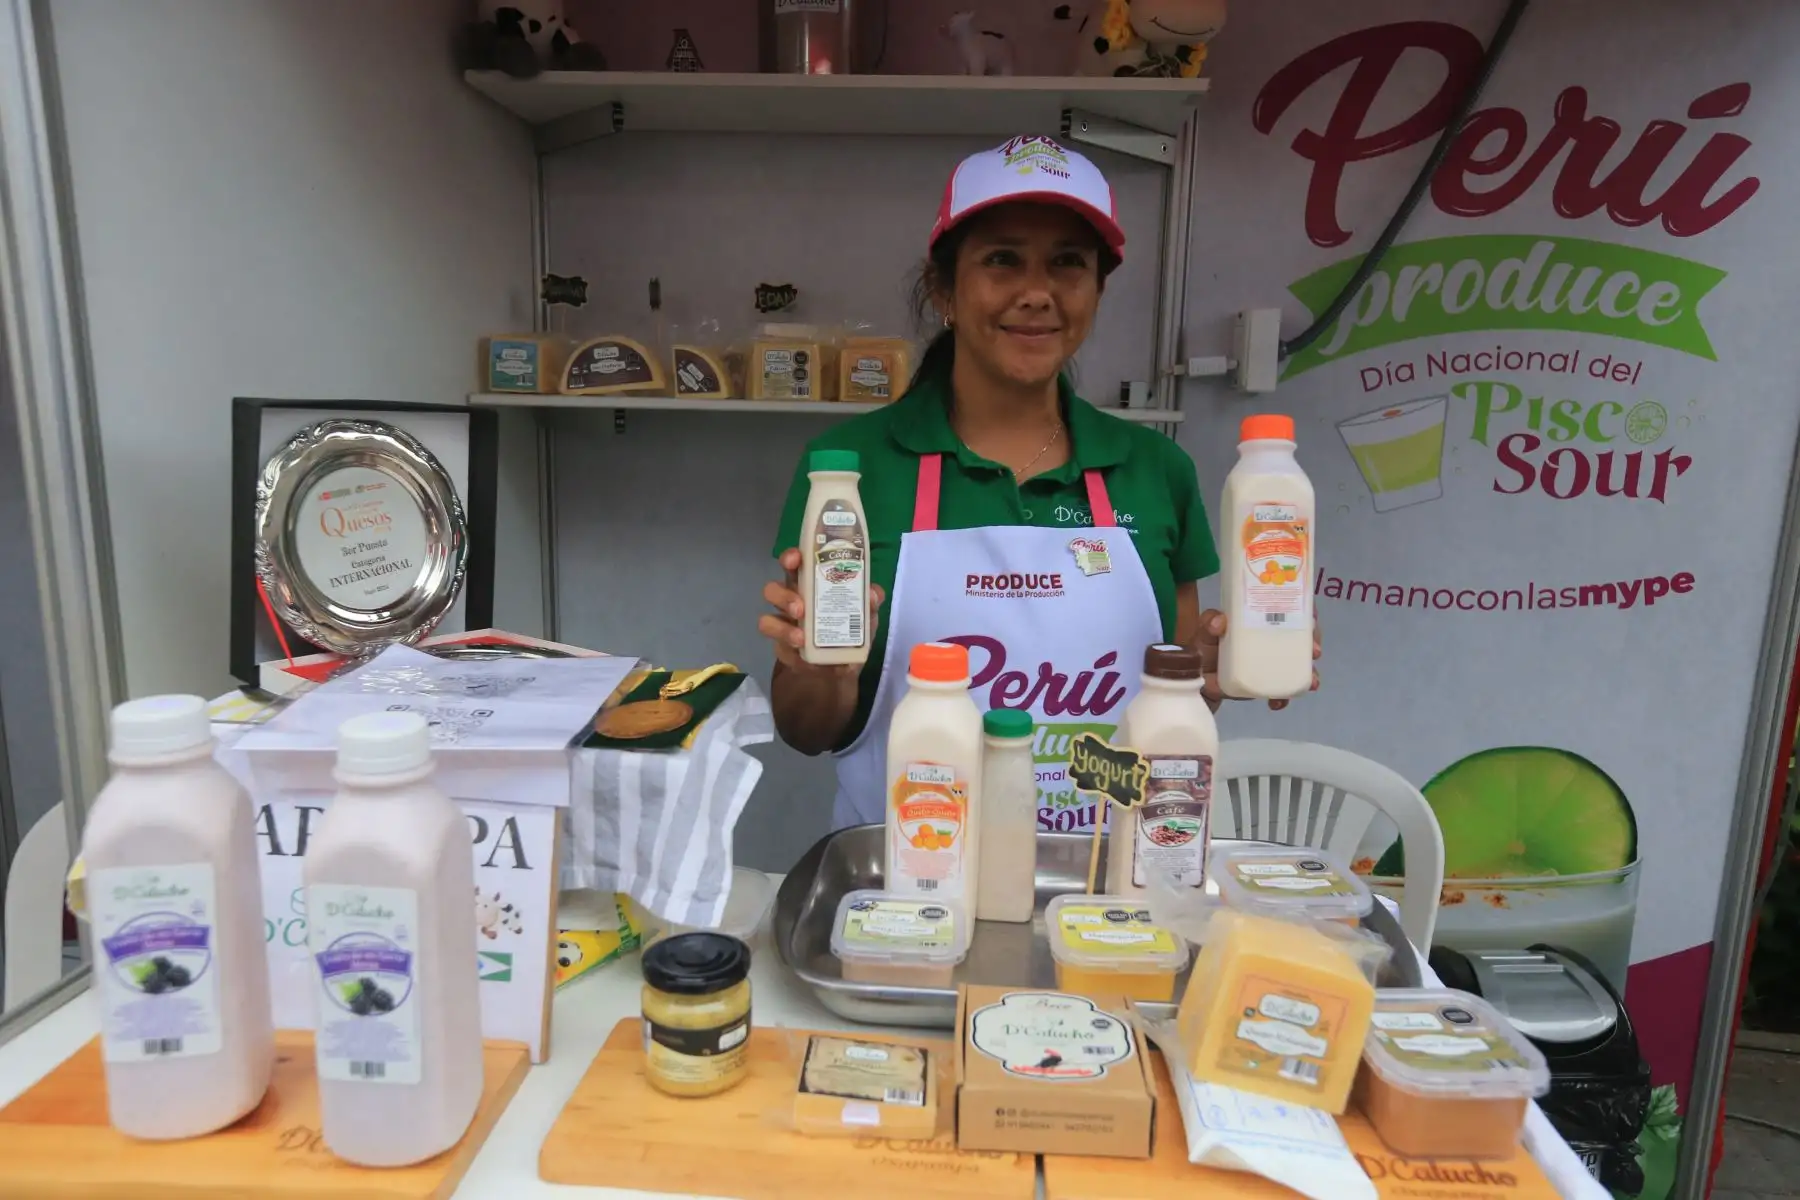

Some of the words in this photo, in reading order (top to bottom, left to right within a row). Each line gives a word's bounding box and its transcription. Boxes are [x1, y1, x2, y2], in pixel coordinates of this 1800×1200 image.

[1252, 20, 1761, 248] Perú
[1317, 241, 1684, 356] produce
[1360, 361, 1416, 392] Día
[1426, 345, 1580, 377] Nacional
[1588, 354, 1643, 385] del
[1493, 433, 1693, 504] Sour
[320, 507, 392, 538] Quesos
[329, 558, 413, 588] INTERNACIONAL
[966, 574, 1063, 590] PRODUCE
[965, 590, 1005, 599] Ministerio
[1006, 590, 1015, 598] de
[1016, 590, 1024, 598] la
[1025, 590, 1065, 598] Producción
